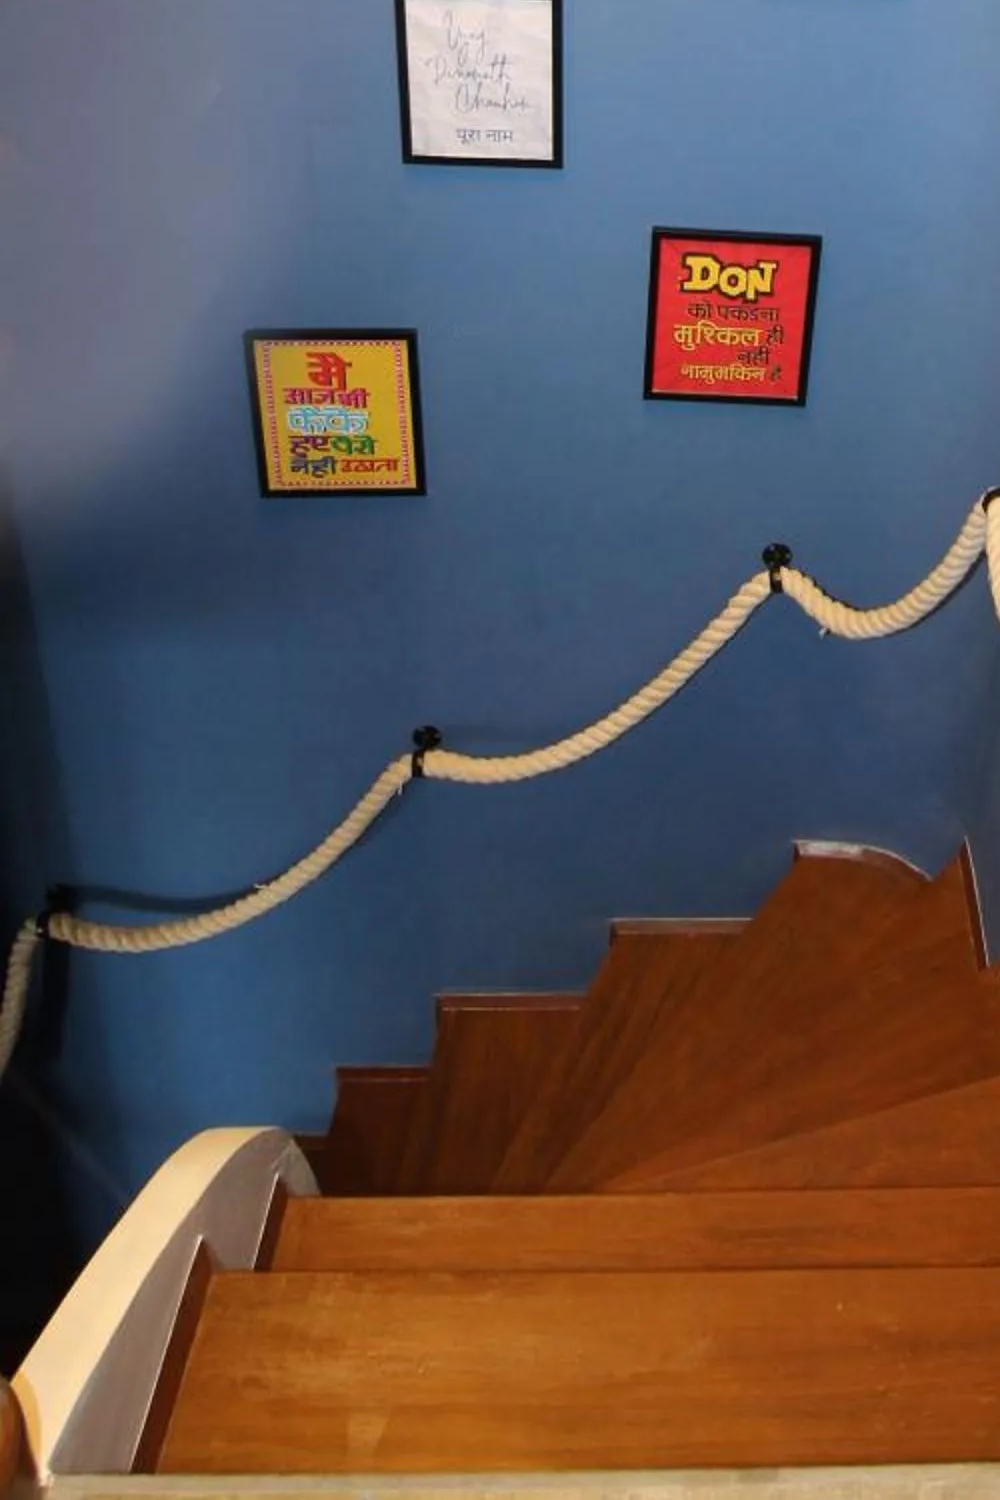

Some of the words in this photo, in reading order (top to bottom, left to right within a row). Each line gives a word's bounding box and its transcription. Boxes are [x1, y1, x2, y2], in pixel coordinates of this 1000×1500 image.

[485, 129, 514, 143] नाम
[680, 252, 779, 302] DON
[687, 300, 713, 320] को
[672, 320, 764, 351] मुश्किल
